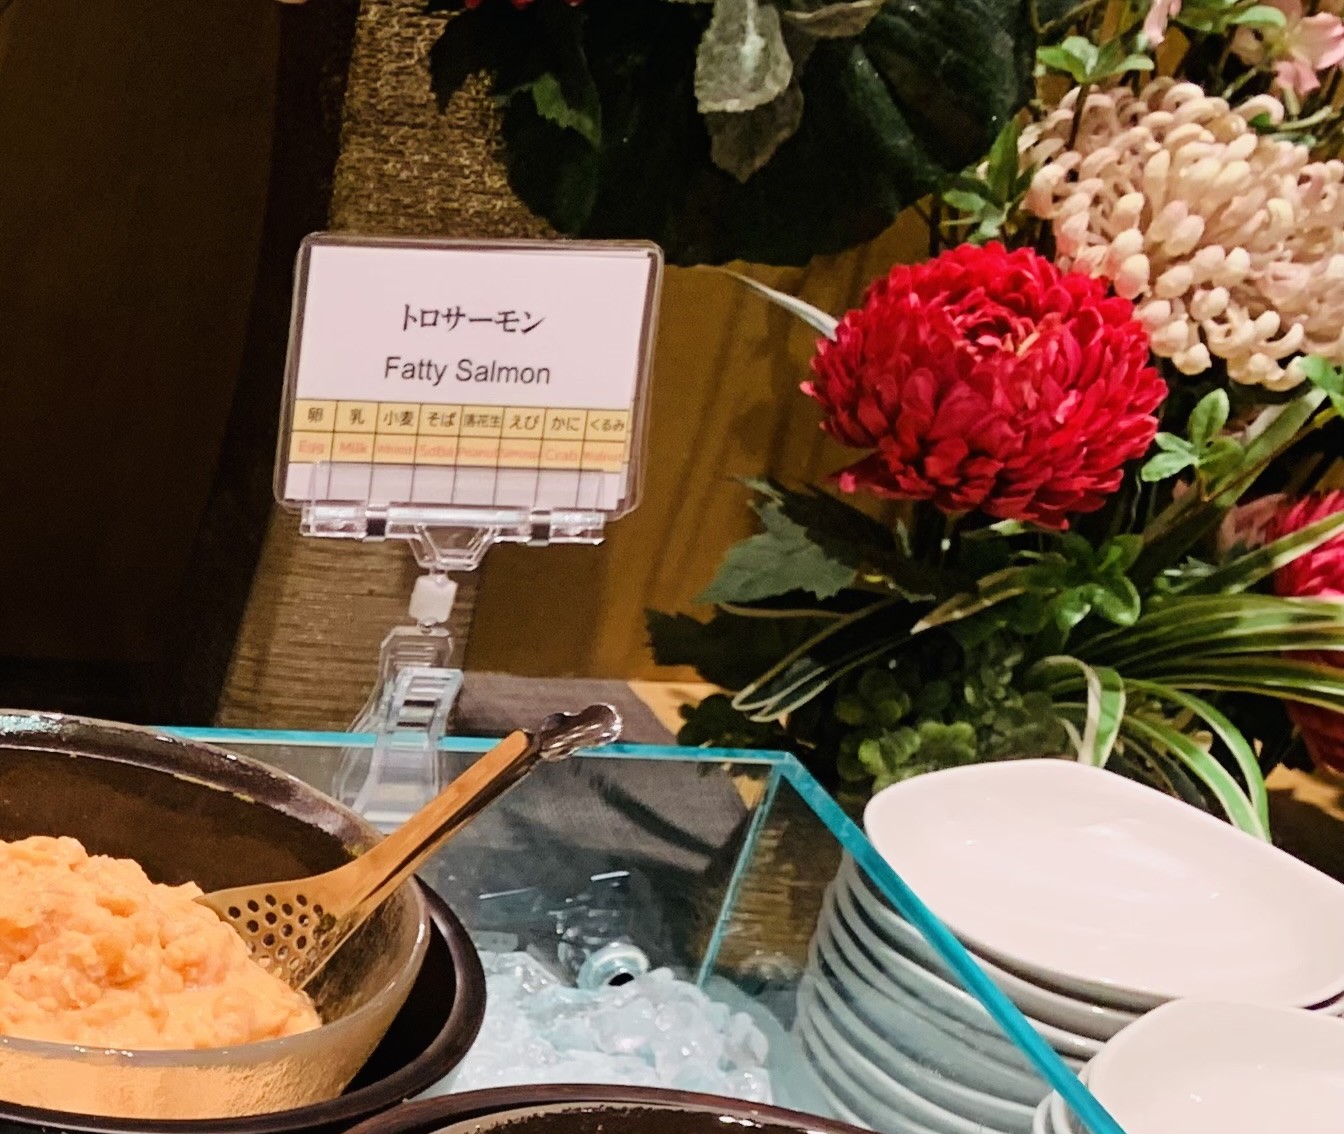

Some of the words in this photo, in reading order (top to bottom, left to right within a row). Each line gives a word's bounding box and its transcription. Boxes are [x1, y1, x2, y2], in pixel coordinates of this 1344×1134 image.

[402, 303, 546, 334] トロサーモン
[384, 356, 448, 387] Fatty
[455, 358, 551, 385] Salmon
[350, 408, 365, 425] 乳
[383, 410, 413, 427] 小麦
[509, 414, 541, 431] えび
[551, 415, 581, 432] かに
[590, 418, 625, 433] くるみ
